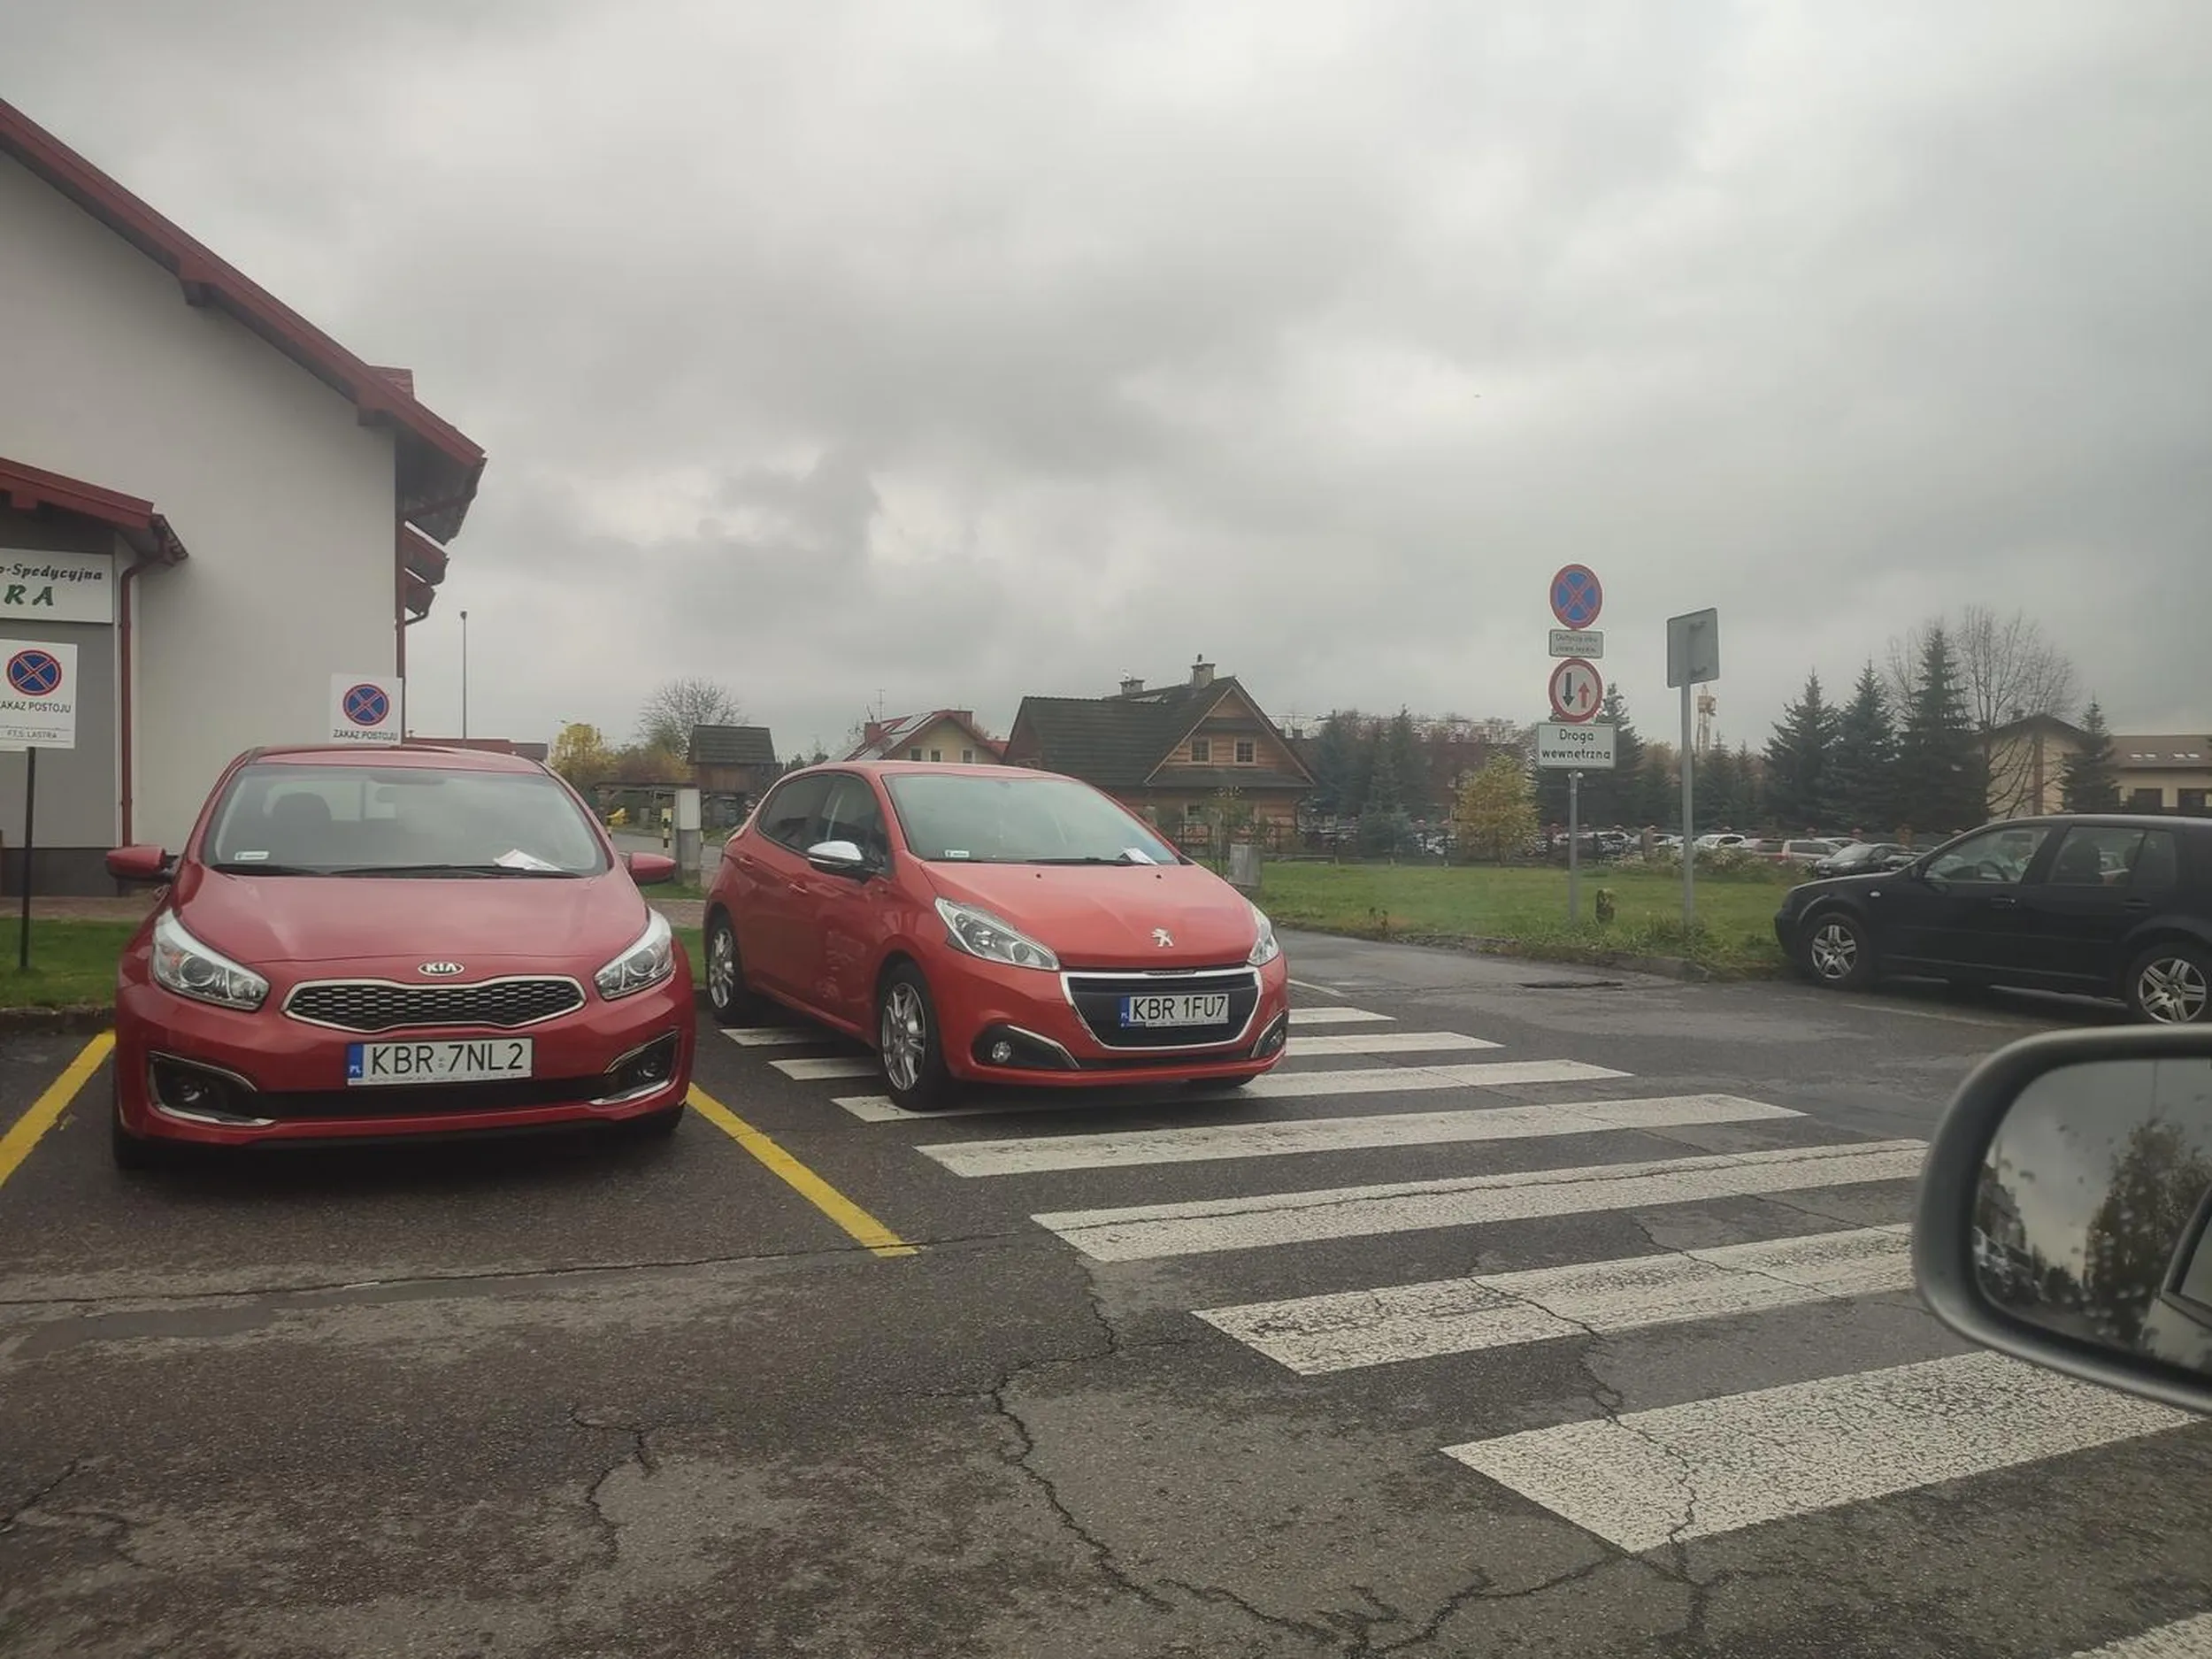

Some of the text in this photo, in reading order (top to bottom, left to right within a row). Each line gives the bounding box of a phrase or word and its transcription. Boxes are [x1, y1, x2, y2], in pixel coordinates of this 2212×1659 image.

[0, 701, 72, 713] AKAZ POSTOJU
[27, 730, 57, 739] LASTRA
[333, 729, 398, 741] ZAKAZ POSTOJU
[1559, 728, 1594, 744] Droga
[426, 962, 457, 972] KIA
[1133, 995, 1226, 1020] KBR 1FU7
[371, 1042, 524, 1075] KBR 7NL2
